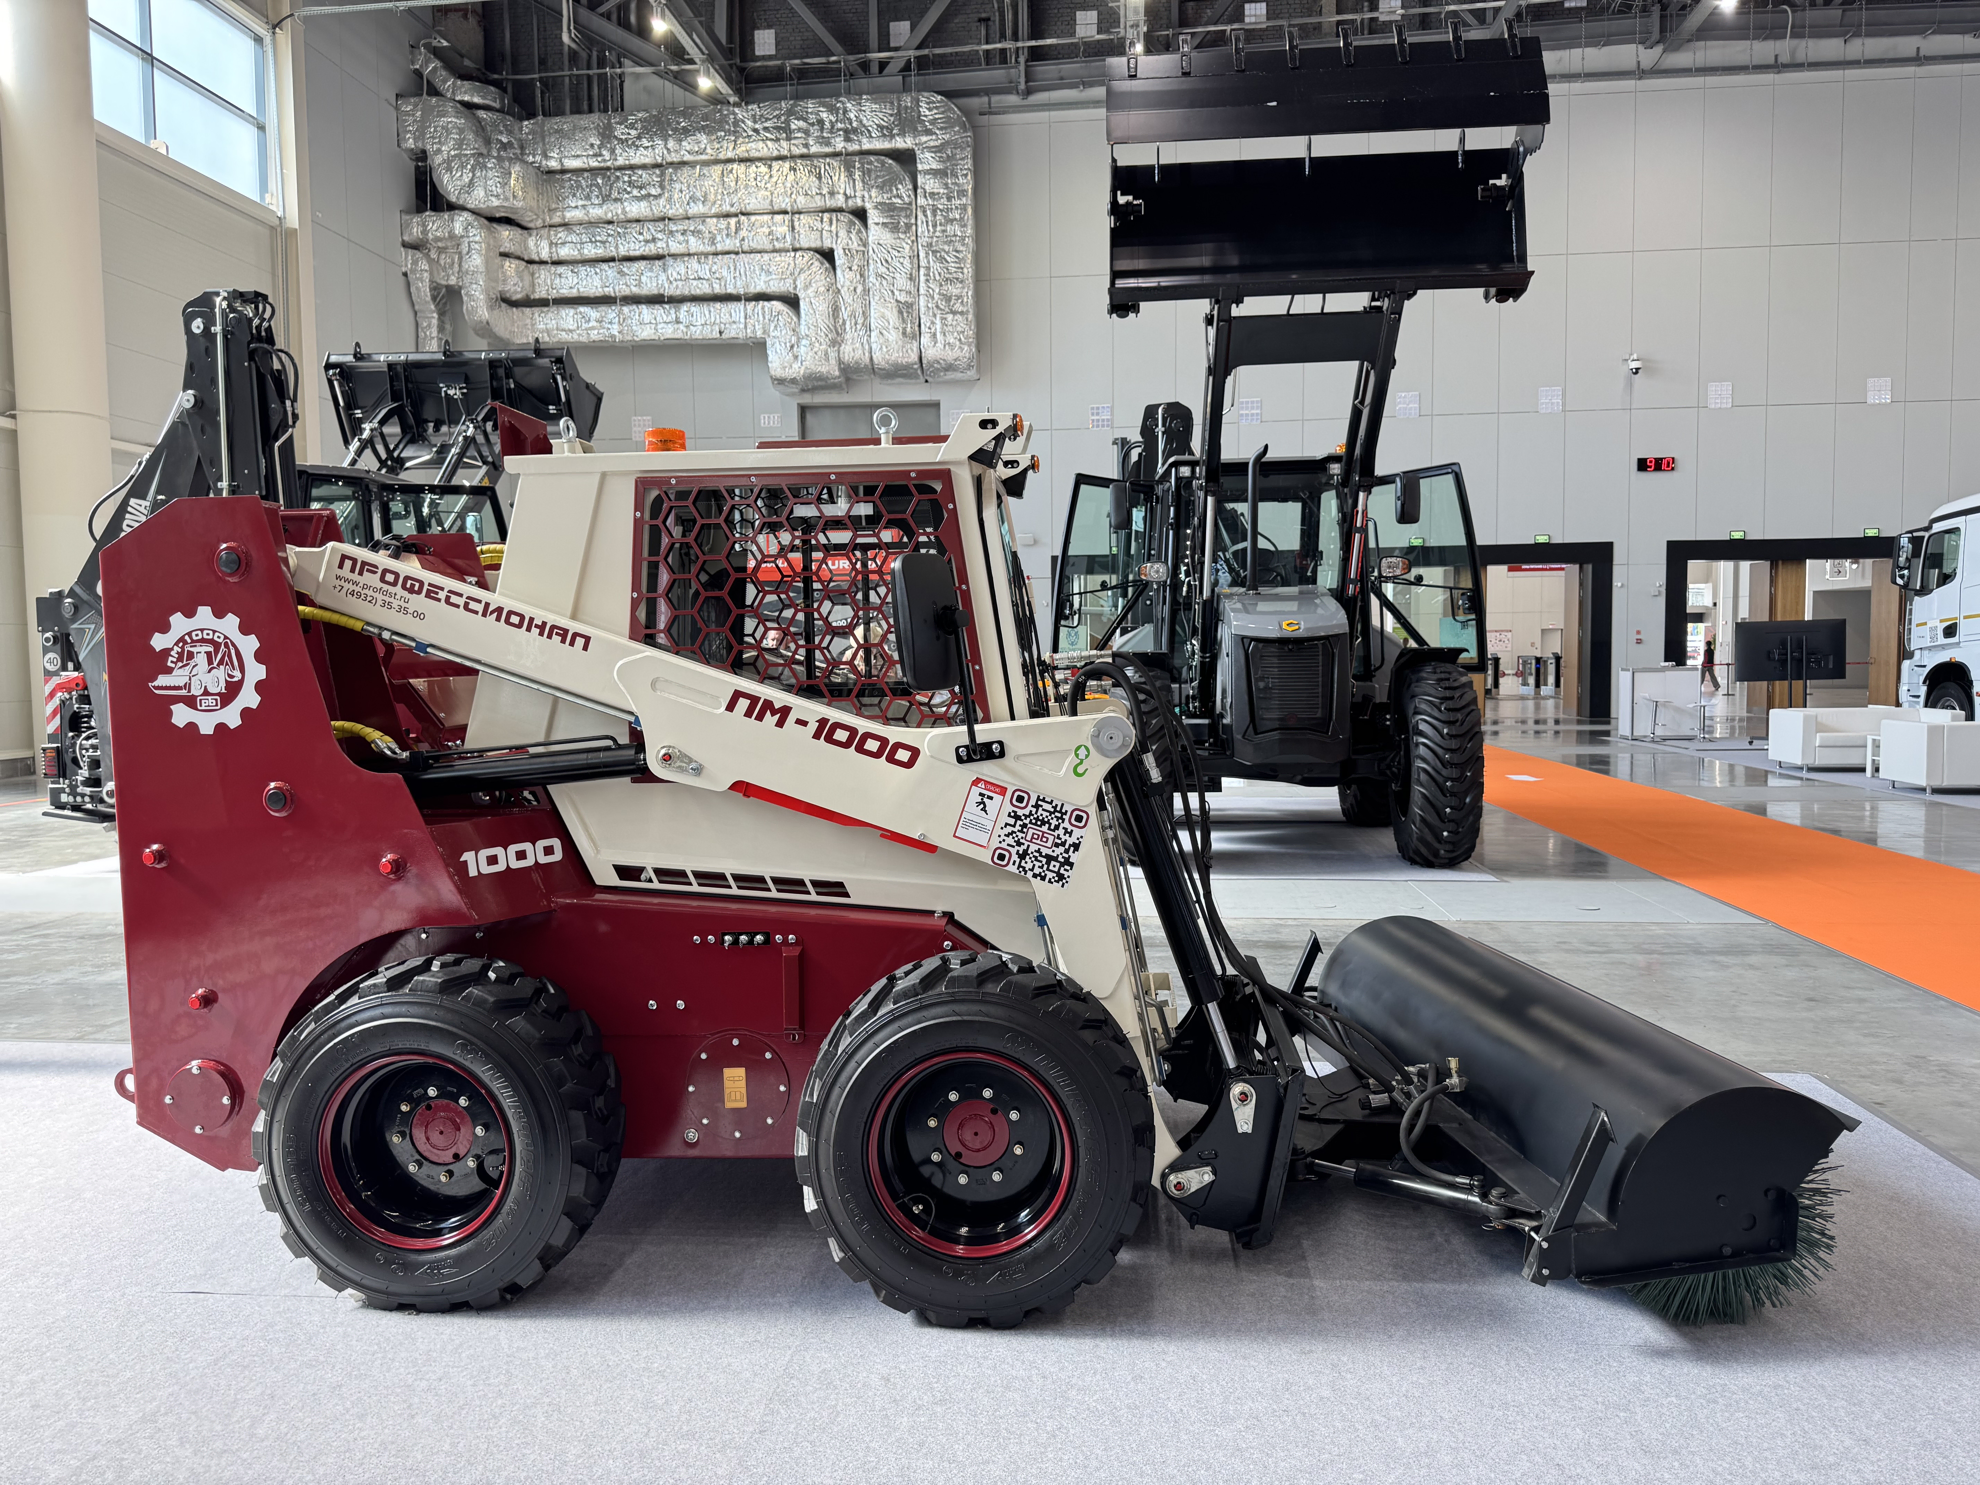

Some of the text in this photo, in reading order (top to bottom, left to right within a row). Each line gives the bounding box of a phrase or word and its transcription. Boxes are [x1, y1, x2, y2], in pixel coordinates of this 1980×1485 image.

[119, 497, 150, 538] OVA
[332, 583, 426, 621] +7 (4932) 35-35-00
[335, 573, 410, 604] www.profdst.ru
[45, 656, 59, 667] 40
[167, 629, 225, 668] ПМ-1000
[725, 688, 921, 770] ПМ-1000
[459, 837, 563, 878] 1000
